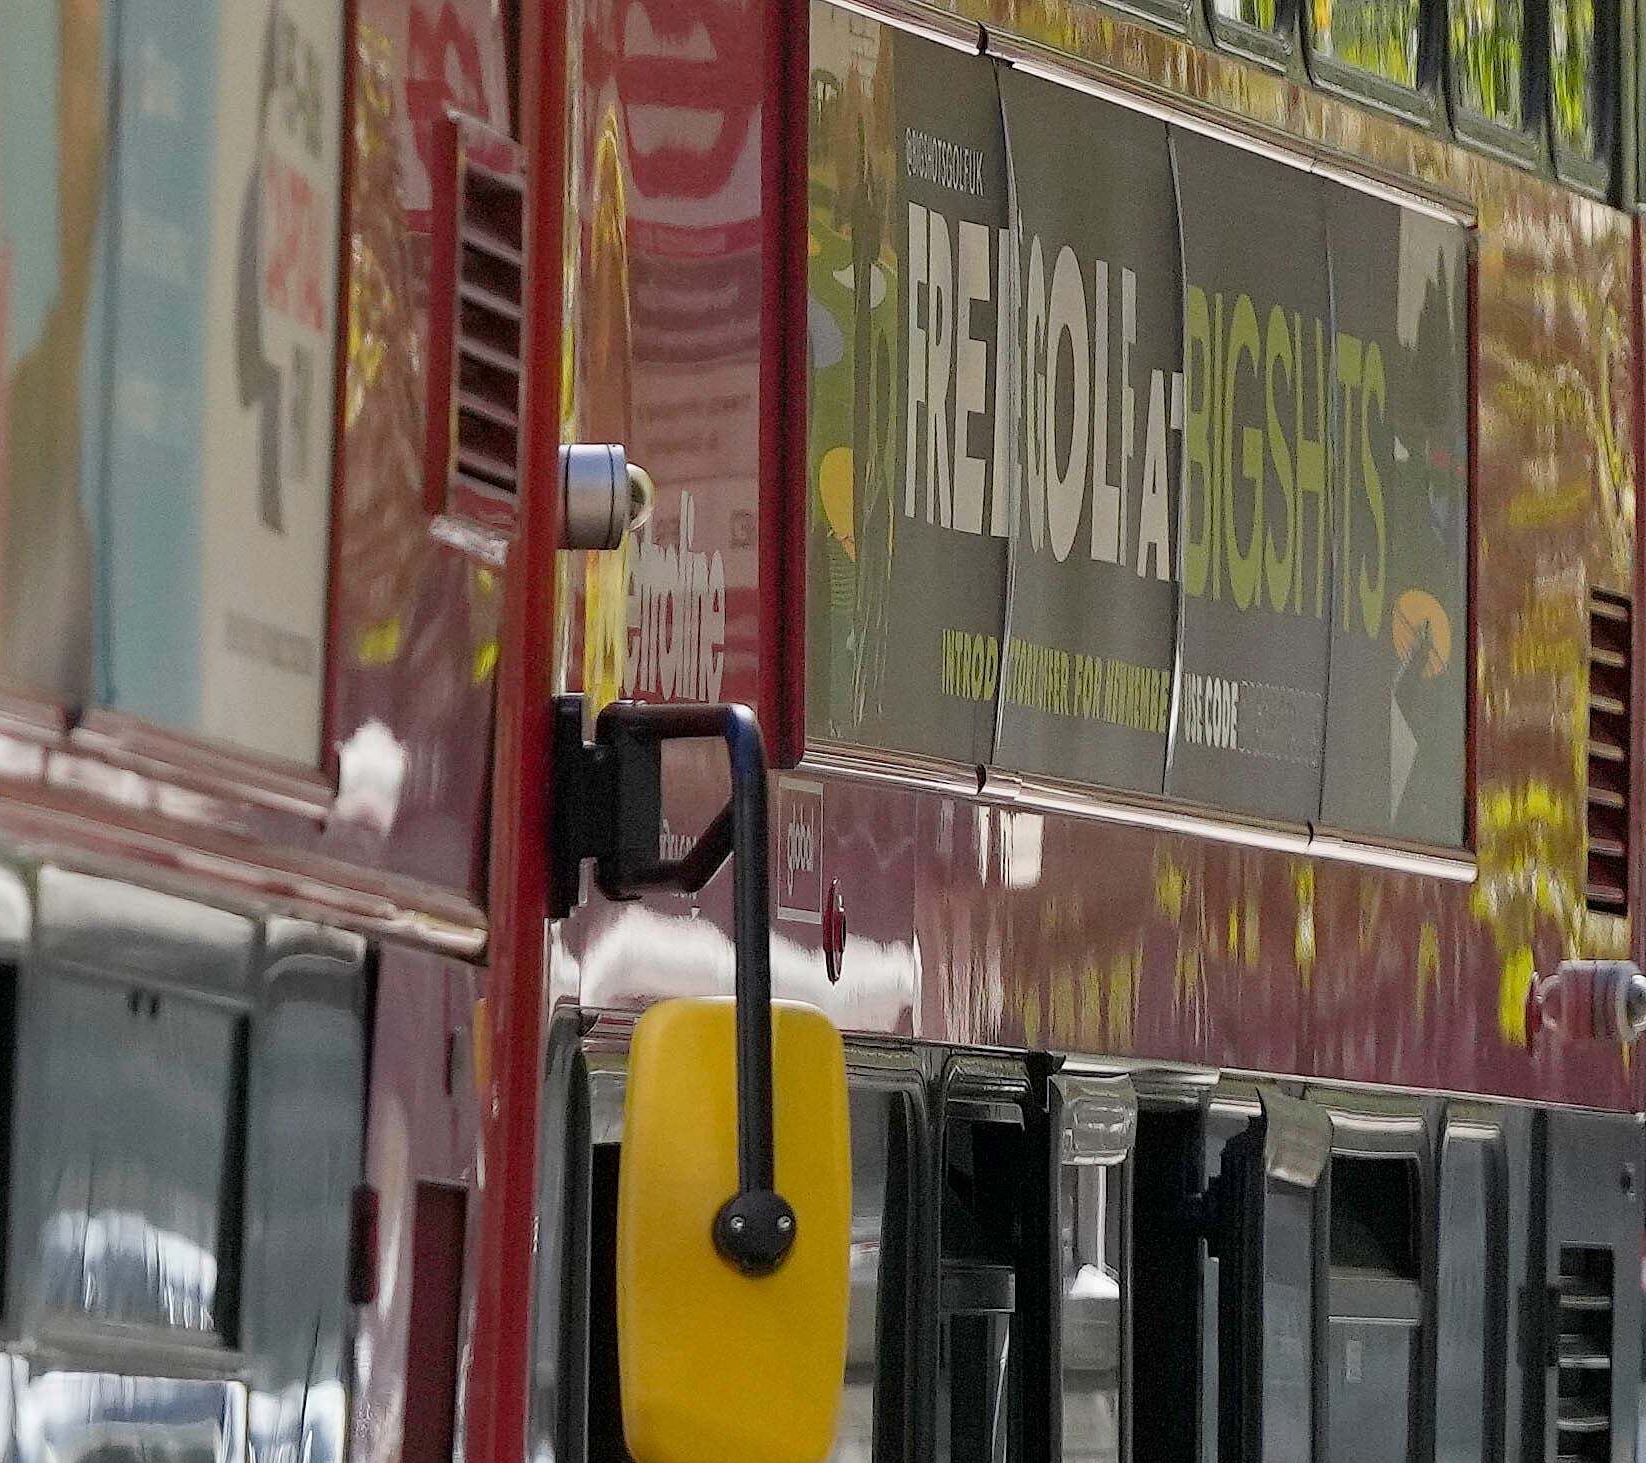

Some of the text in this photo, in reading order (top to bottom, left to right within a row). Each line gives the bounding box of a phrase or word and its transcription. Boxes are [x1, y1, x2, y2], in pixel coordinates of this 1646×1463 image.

[1026, 234, 1137, 564] GOLF
[1184, 284, 1387, 640] BIGSHTS
[1184, 672, 1203, 745] USE
[1205, 675, 1239, 750] CODE
[787, 802, 815, 896] global
